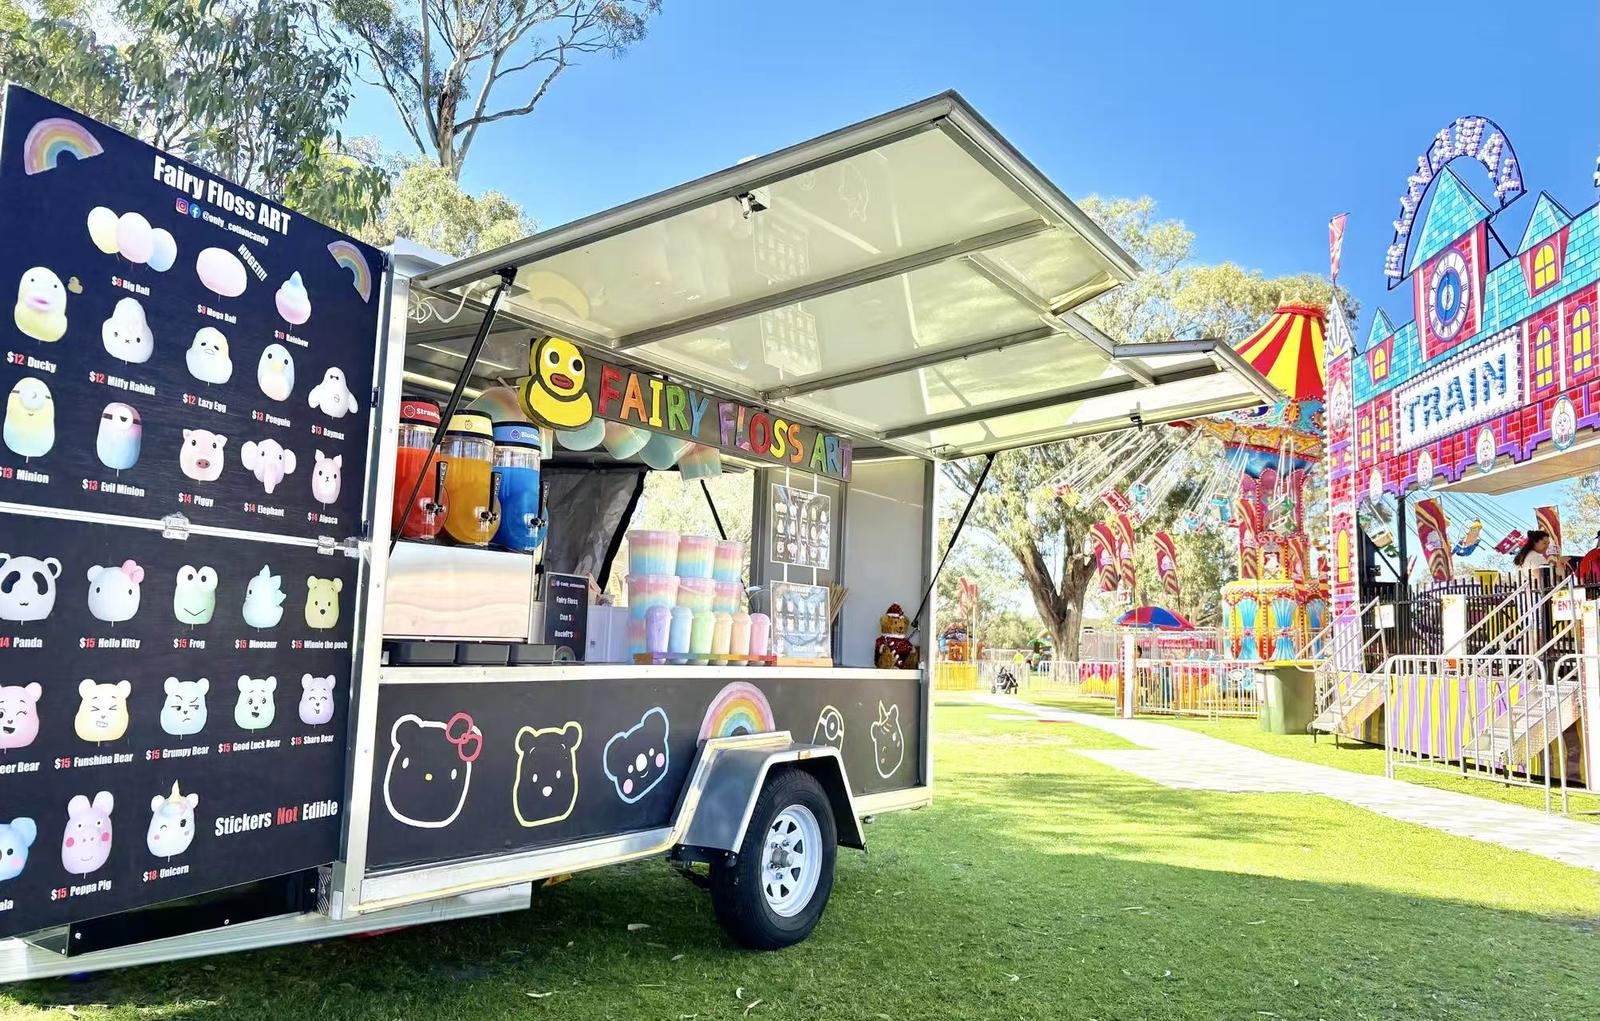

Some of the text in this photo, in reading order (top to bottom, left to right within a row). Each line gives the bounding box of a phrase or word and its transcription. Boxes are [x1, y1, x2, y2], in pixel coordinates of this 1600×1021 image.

[154, 155, 292, 236] Fairy Floss ART
[122, 280, 135, 292] Big
[136, 284, 150, 296] Ball
[206, 307, 224, 320] Mega
[224, 312, 237, 324] Ball
[286, 333, 309, 348] Rainbow
[6, 351, 57, 374] $12 Ducky
[88, 370, 156, 396] $12 Miffy Rabbit
[1403, 352, 1507, 433] TRAIN
[182, 393, 227, 414] $12 Lazy Egg
[265, 413, 291, 428] Penguin
[597, 363, 850, 480] FAIRY FLOSS ART
[322, 428, 345, 440] Baymax
[16, 468, 50, 484] Minion
[82, 478, 145, 498] $13 Evil Minion
[194, 494, 214, 508] Piggy
[244, 502, 285, 518] $14 Elephant
[319, 514, 338, 525] Alpaca
[13, 636, 42, 648] Panda
[79, 636, 141, 650] $15 Hello Kitty
[173, 638, 206, 650] $15 Frog
[234, 638, 278, 649] $15 Dinosaur
[304, 640, 324, 649] Winnie
[324, 640, 333, 649] the
[333, 640, 348, 650] pooh
[218, 739, 281, 754] $15 Good Luck Bear
[291, 734, 334, 746] $15 Share Bear
[54, 752, 134, 770] $15 Funshine Bear
[146, 745, 209, 761] $15 Grumpy Bear
[17, 761, 40, 772] Bear
[214, 800, 338, 837] Stickers Not Edible
[160, 864, 190, 878] Unicorn
[50, 879, 112, 901] $15 Peppa Pig
